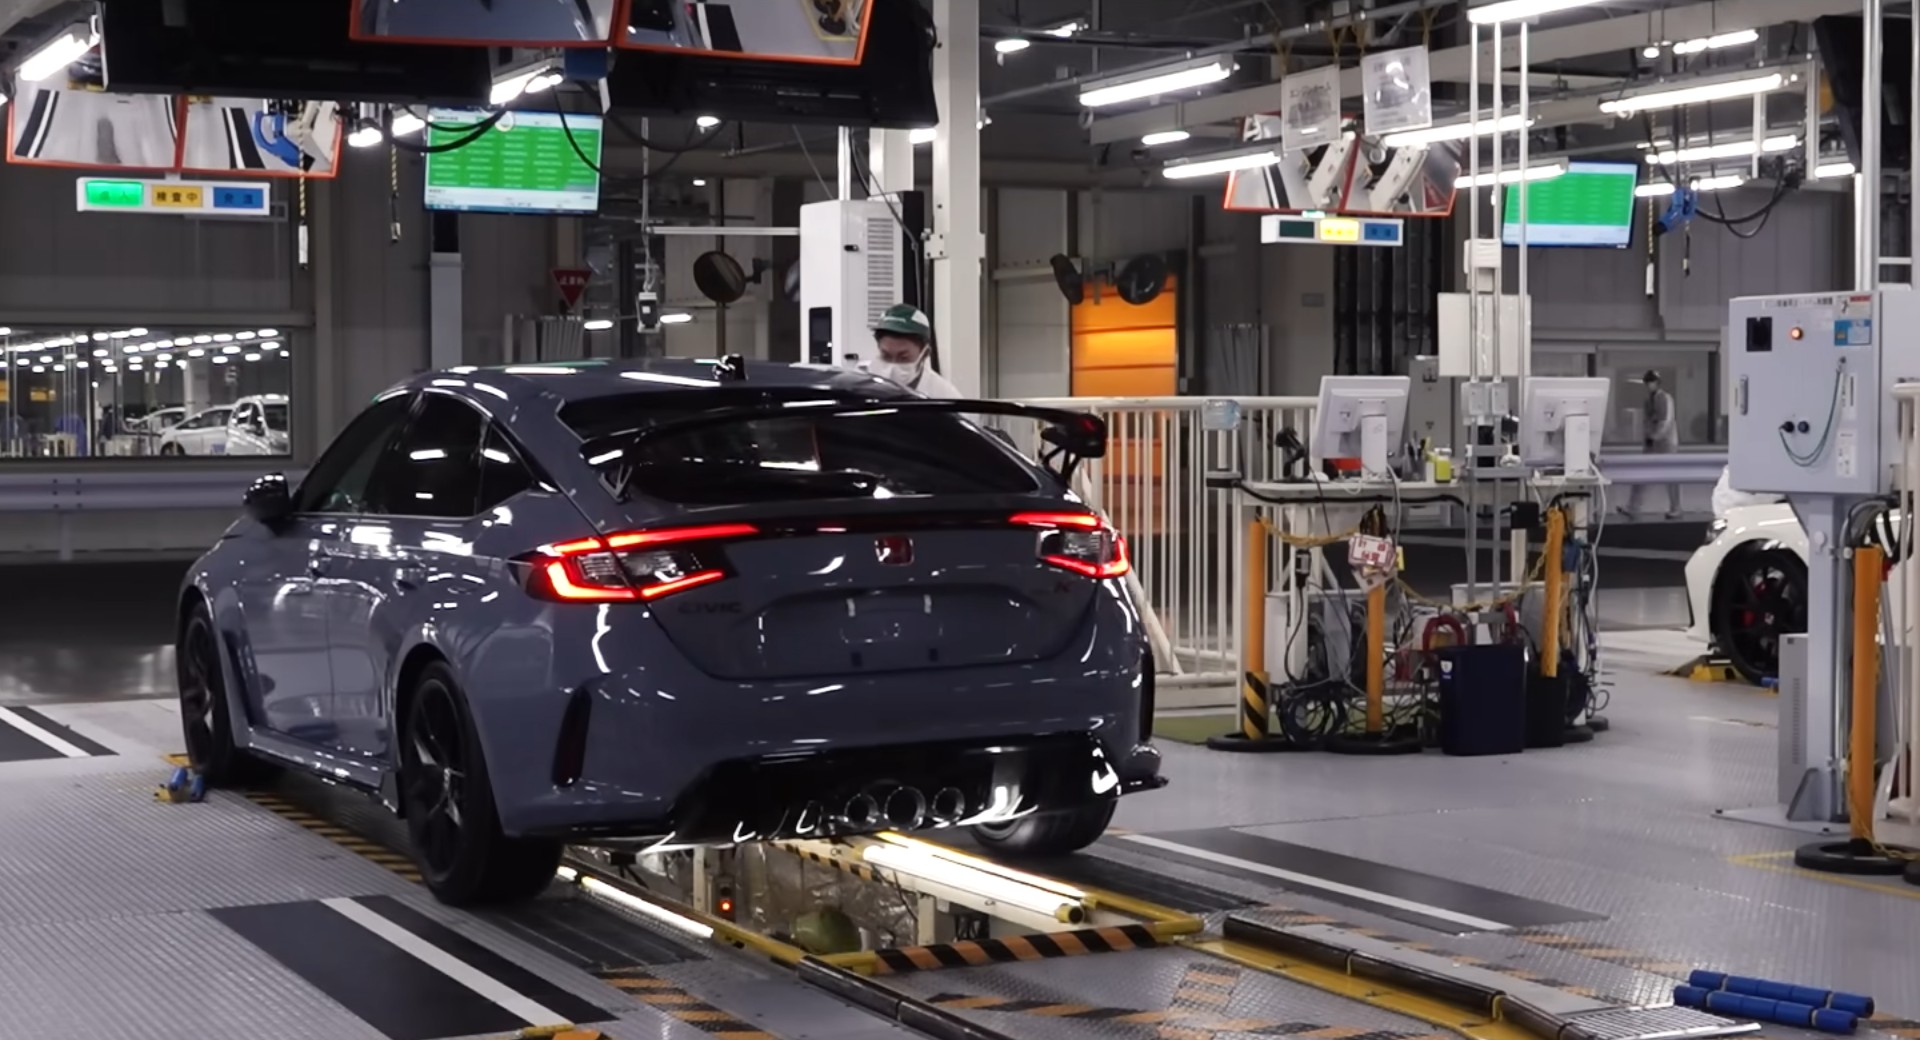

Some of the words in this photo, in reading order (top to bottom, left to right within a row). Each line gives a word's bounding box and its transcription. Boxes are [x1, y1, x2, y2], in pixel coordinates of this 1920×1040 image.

[156, 191, 198, 203] 検査中
[678, 601, 742, 614] CIVIC
